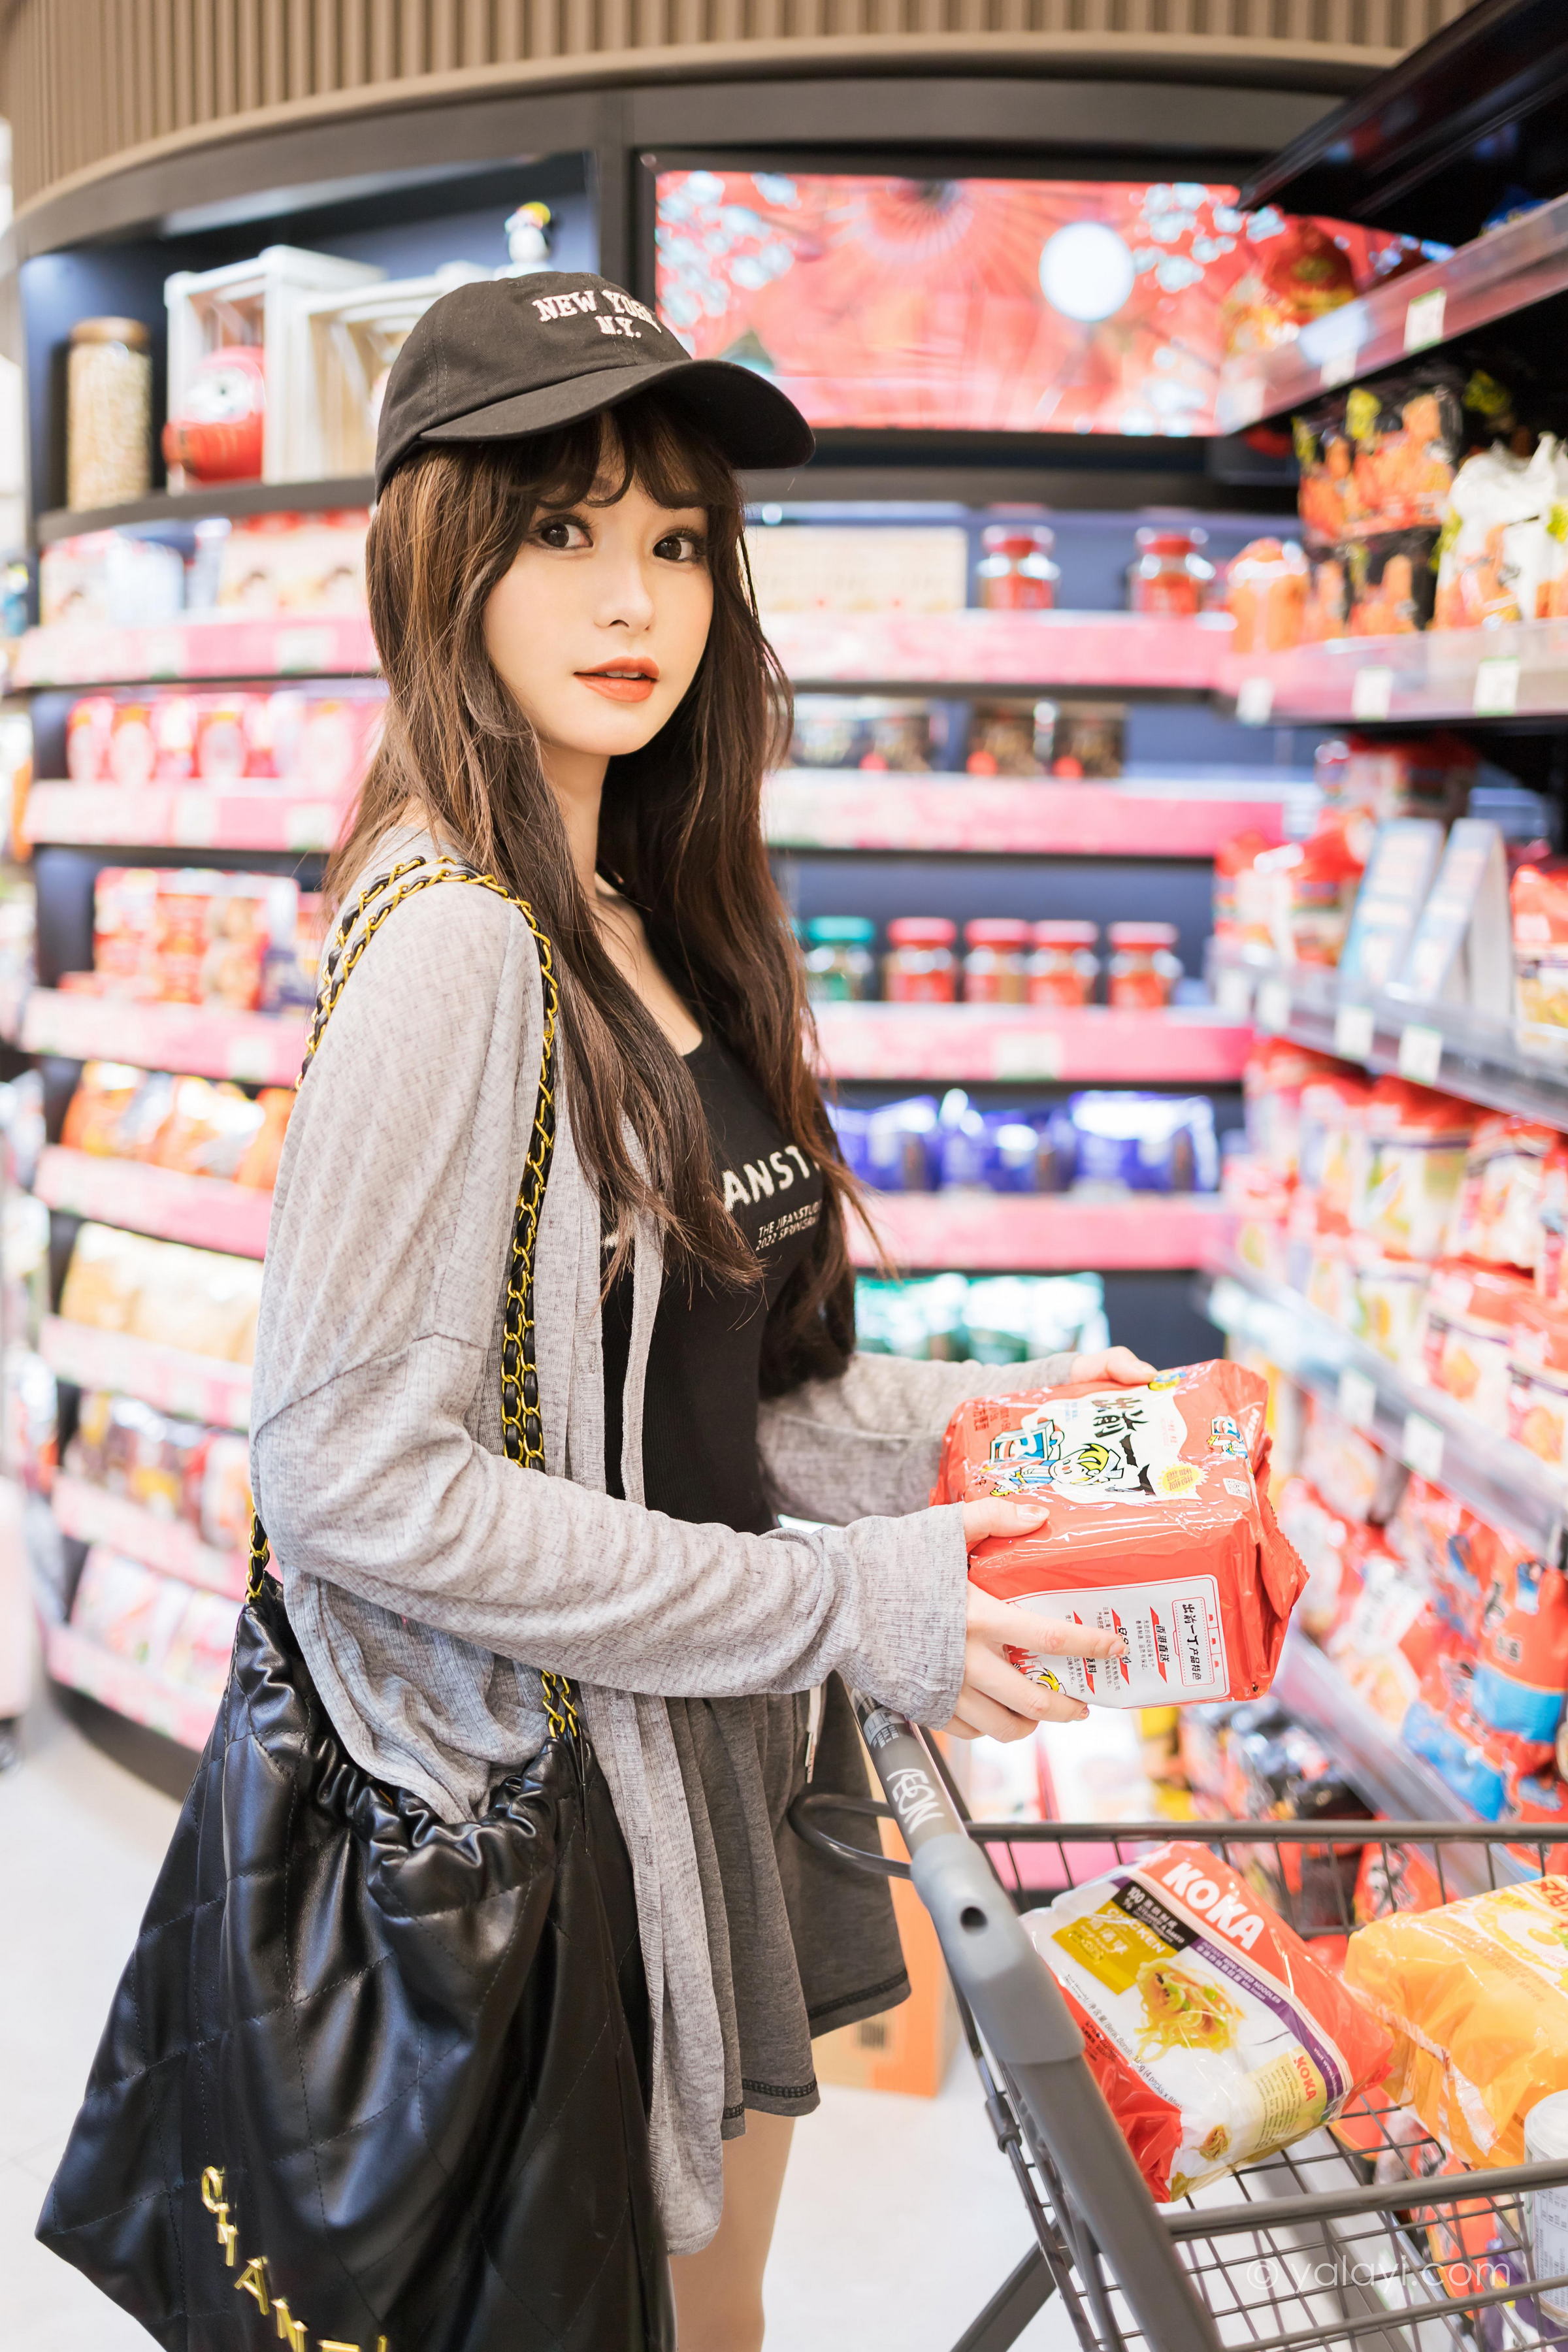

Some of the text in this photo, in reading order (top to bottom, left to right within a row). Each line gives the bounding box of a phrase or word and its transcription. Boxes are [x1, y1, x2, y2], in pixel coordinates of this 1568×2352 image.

[531, 289, 662, 334] NEW YORK
[595, 315, 642, 338] N.Y.
[722, 1145, 811, 1212] ANST
[755, 1232, 777, 1251] 2022
[759, 1220, 775, 1239] THE
[1155, 1625, 1170, 1662] 香港直送
[1162, 1862, 1264, 1951] KOKA
[1107, 1906, 1166, 1953] CHCKEN
[1253, 1982, 1282, 2004] NOODLES
[1293, 2055, 1318, 2102] KOKA
[201, 2165, 389, 2352] CHAN
